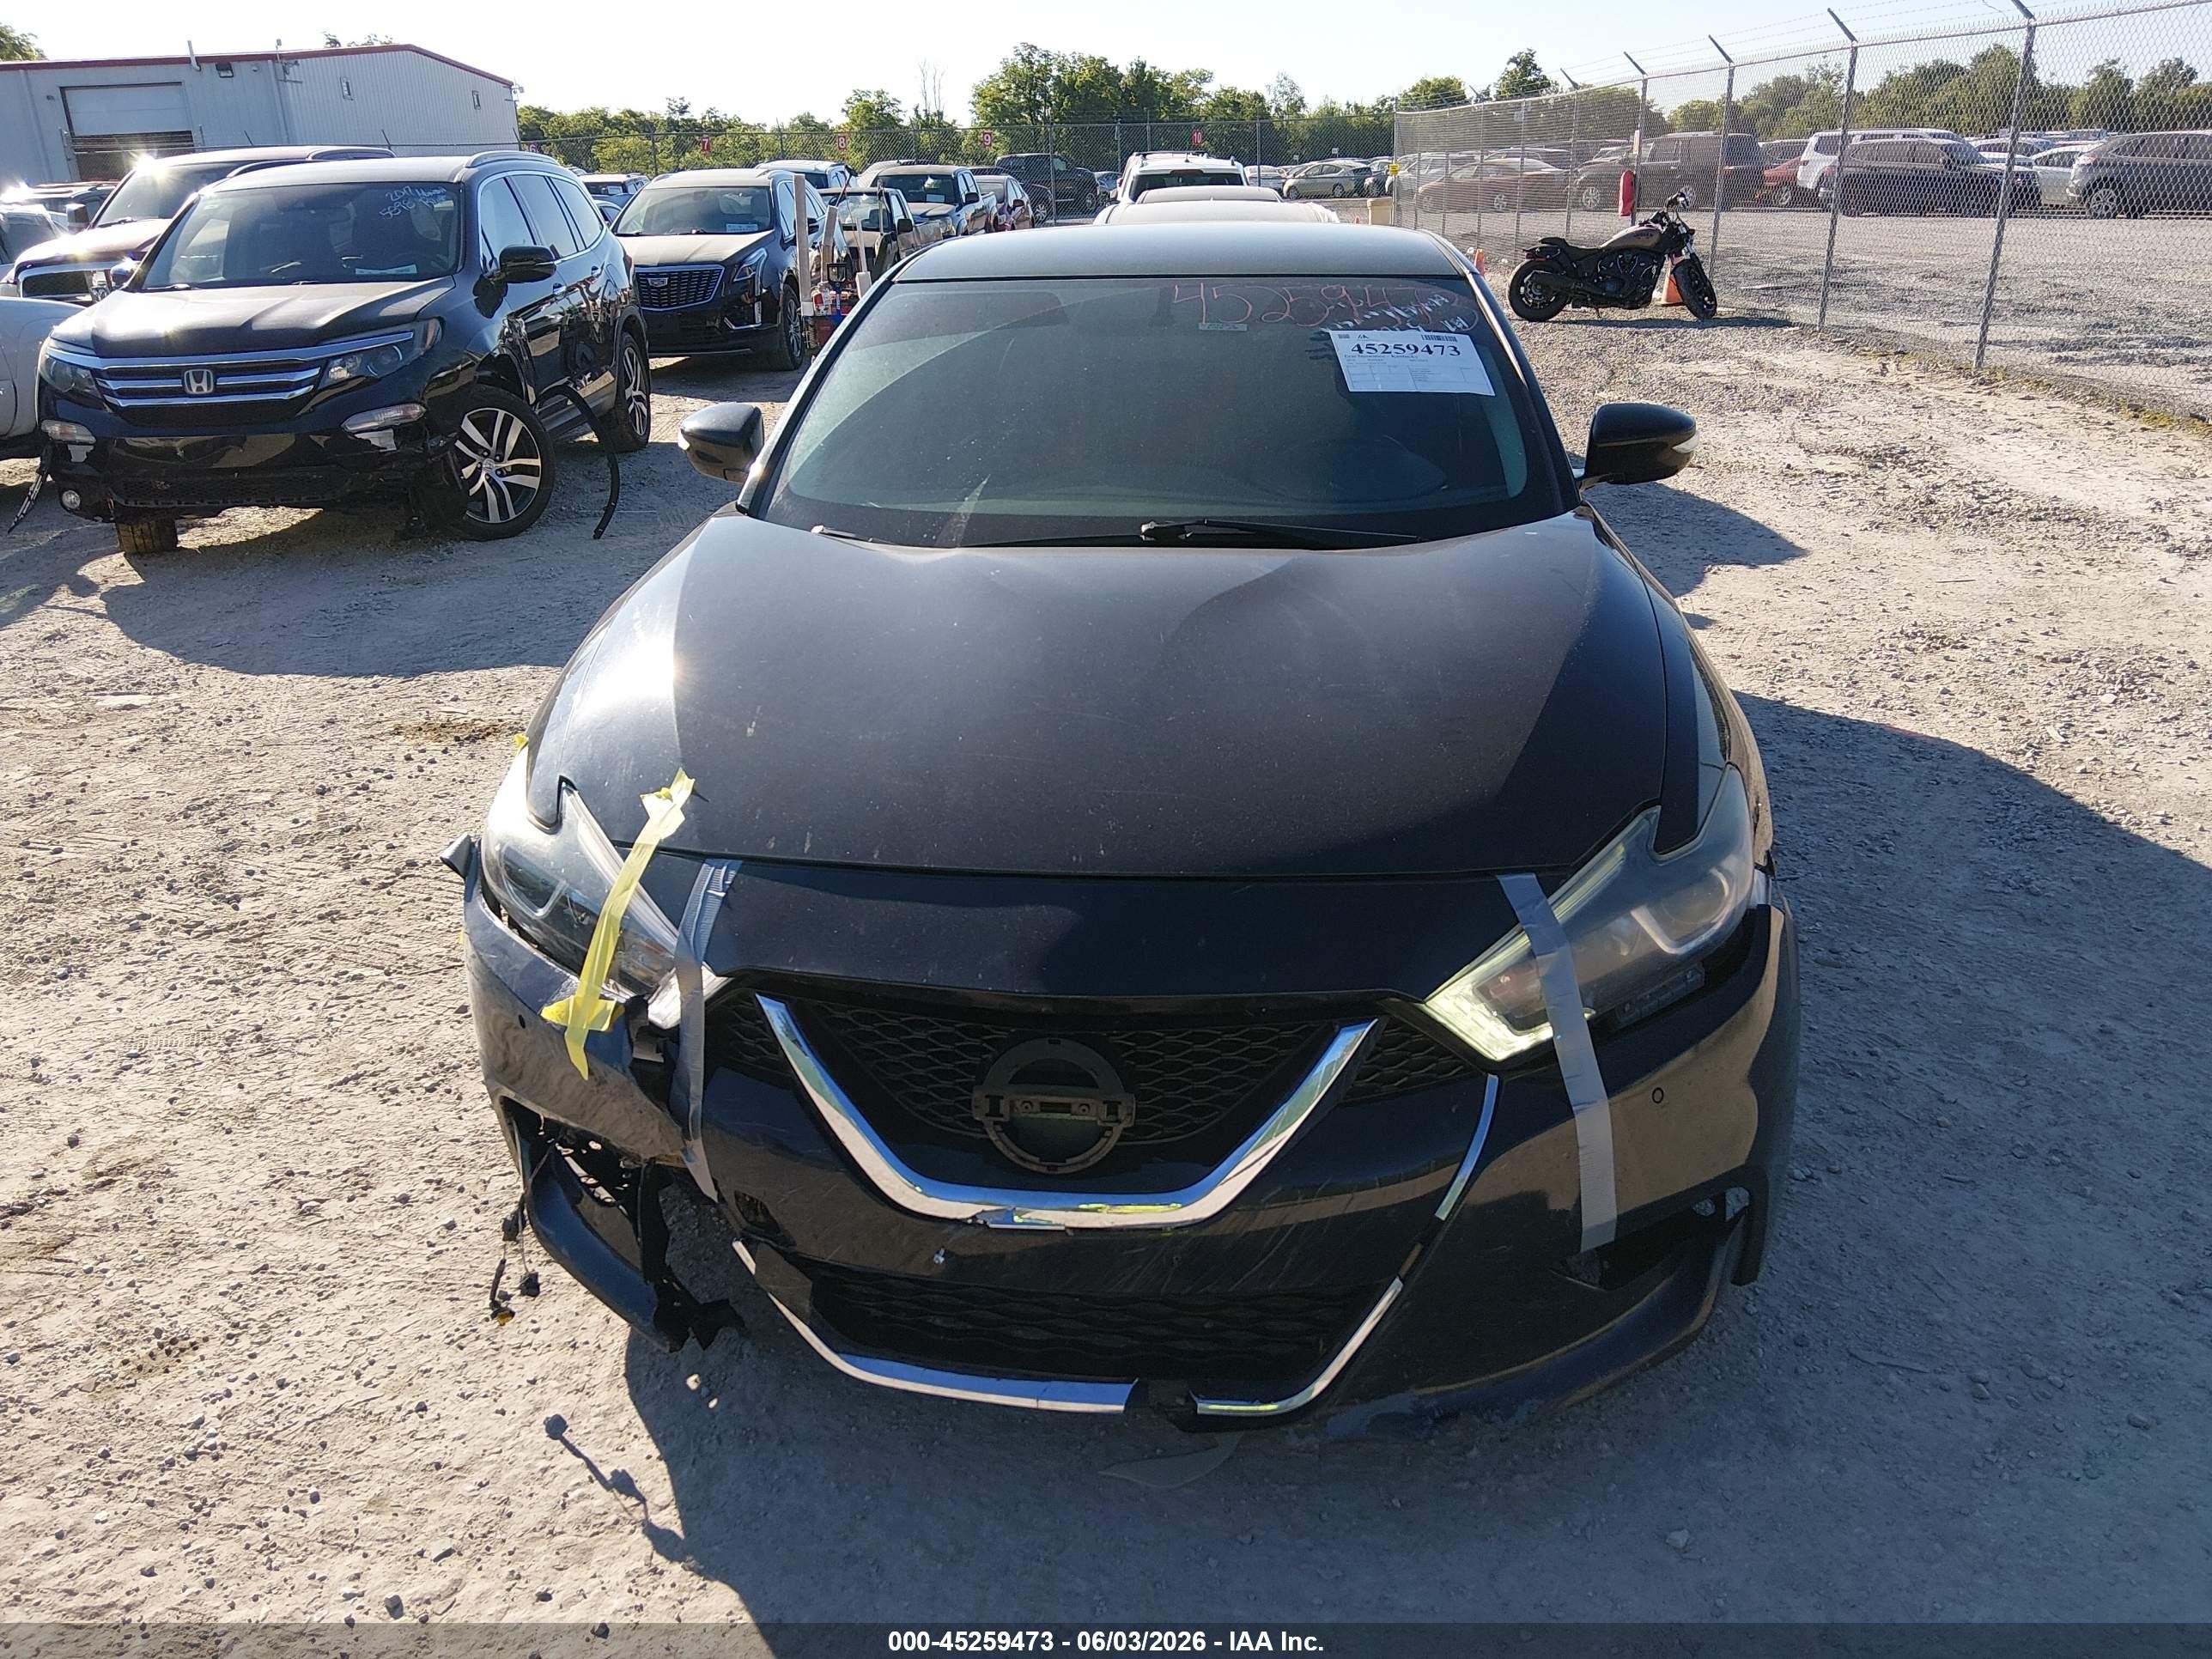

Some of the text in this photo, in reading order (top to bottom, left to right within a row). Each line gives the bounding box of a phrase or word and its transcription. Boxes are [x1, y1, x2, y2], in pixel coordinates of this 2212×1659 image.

[838, 137, 846, 149] 8
[984, 133, 991, 146] 9
[1194, 131, 1201, 143] 10
[702, 138, 709, 150] 7
[1351, 343, 1461, 356] 45259473
